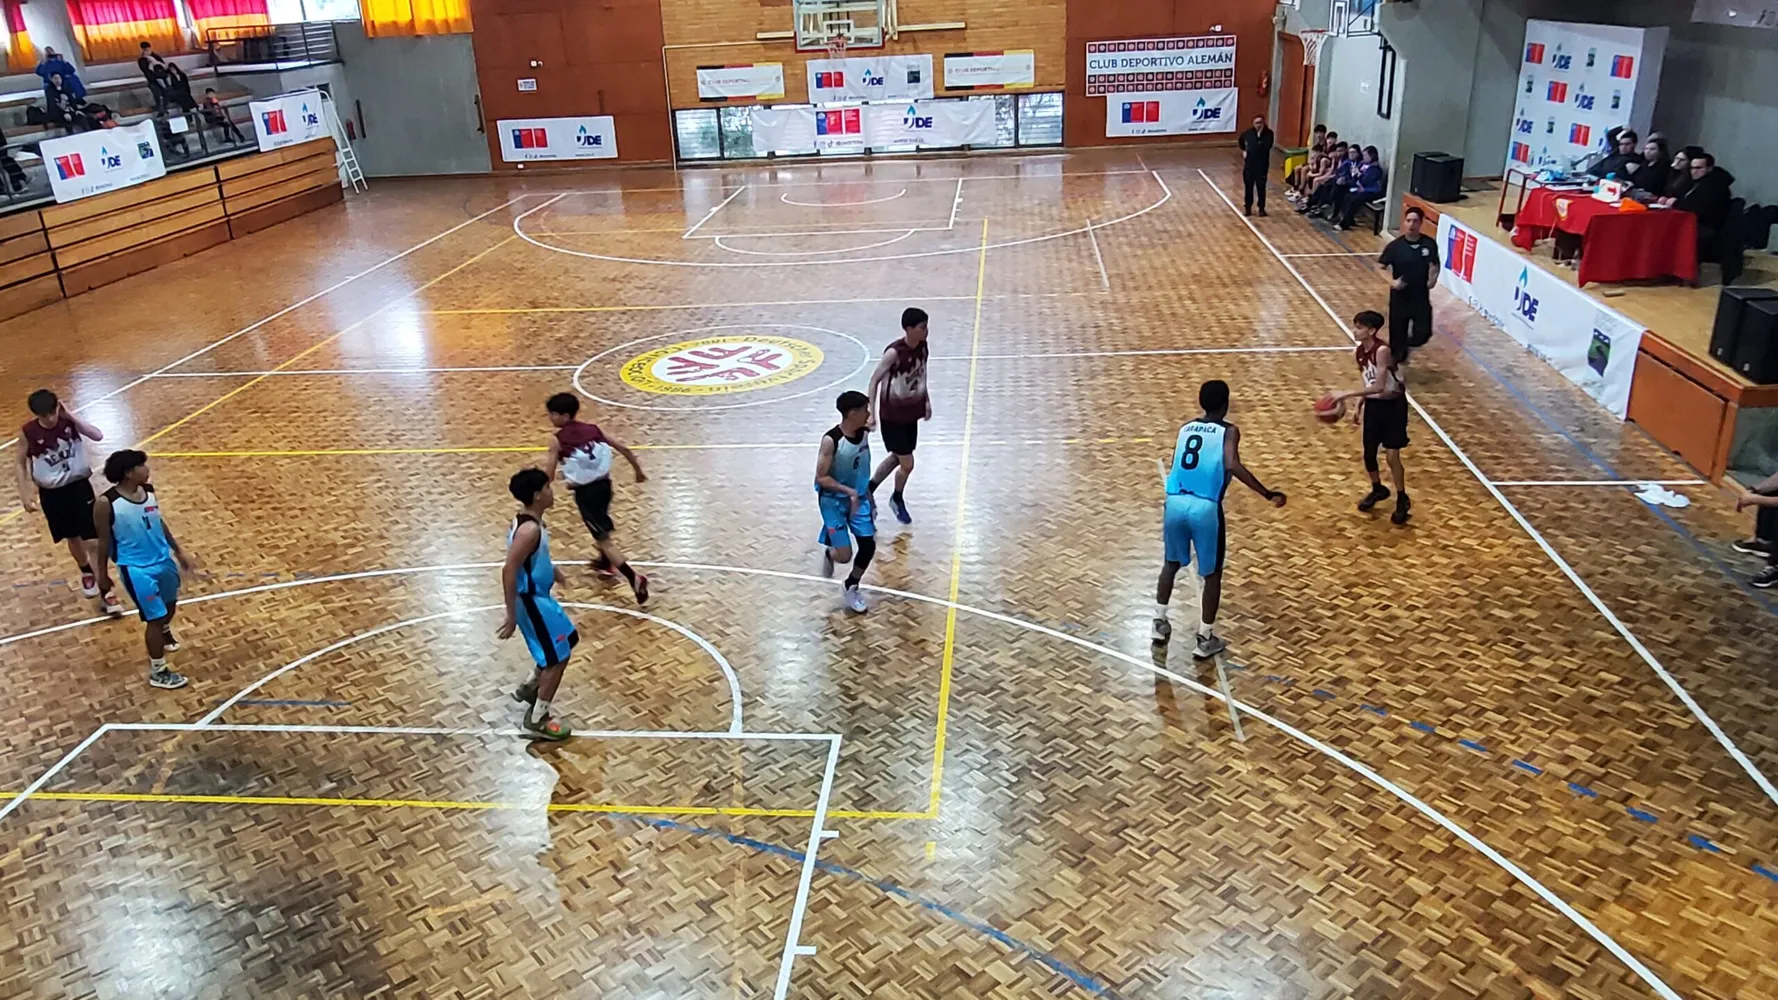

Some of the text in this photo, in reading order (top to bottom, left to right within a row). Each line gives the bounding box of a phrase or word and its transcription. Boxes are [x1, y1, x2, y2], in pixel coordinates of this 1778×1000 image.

[1089, 52, 1233, 69] CLUB DEPORTIVO ALEMÁN
[1181, 434, 1203, 470] 8
